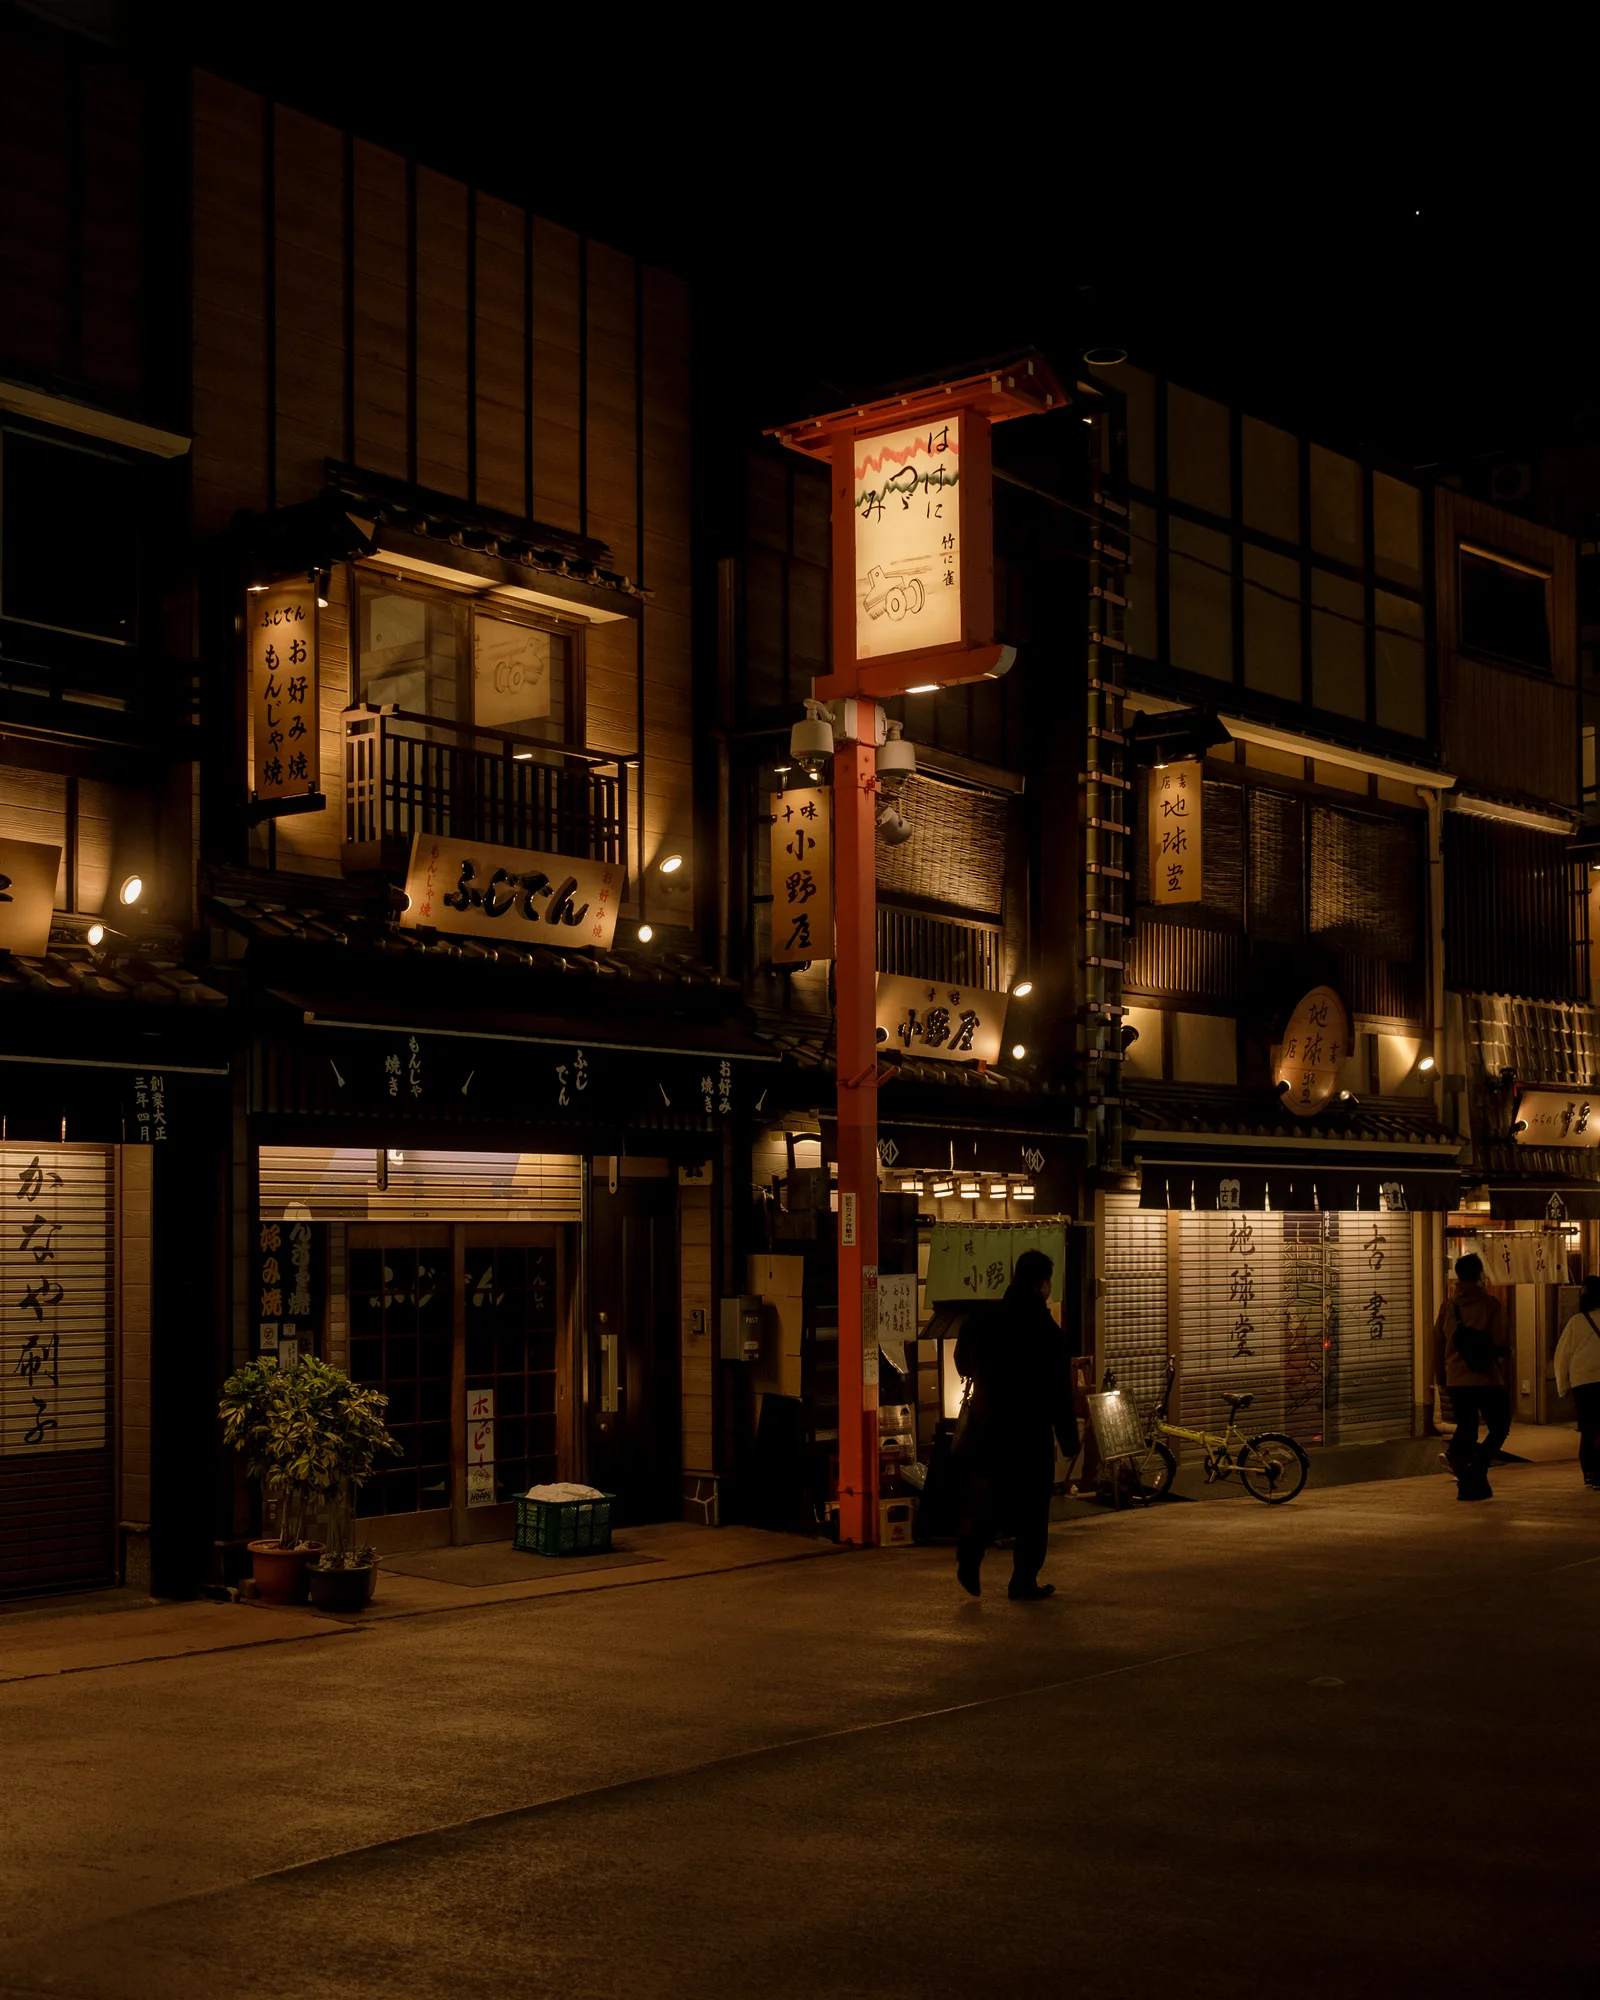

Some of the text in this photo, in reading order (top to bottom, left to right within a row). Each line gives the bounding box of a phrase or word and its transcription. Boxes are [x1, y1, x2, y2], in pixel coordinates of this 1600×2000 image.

[941, 533, 955, 586] 竹に雀
[261, 605, 306, 627] ふじでん
[263, 644, 284, 786] もんじゃ焼
[287, 639, 308, 780] お好み焼
[1160, 794, 1189, 892] 地球堂
[419, 844, 439, 918] もんじゃ焼
[443, 859, 590, 927] ふじでん
[592, 869, 613, 939] お好み焼
[785, 829, 817, 950] 小野屋
[898, 1006, 980, 1051] 小野屋
[1301, 1003, 1328, 1104] 地球堂
[384, 1035, 423, 1098] もんじゃ 焼き
[556, 1049, 588, 1106] ふじ でん
[700, 1060, 732, 1114] お好み 焼き
[134, 1077, 150, 1142] 三年四月
[150, 1075, 167, 1140] 創業大正
[845, 1196, 853, 1239] 防犯カメラ作動中
[1230, 1214, 1256, 1358] 地球堂
[1363, 1223, 1388, 1342] 古書
[745, 1316, 759, 1324] POST
